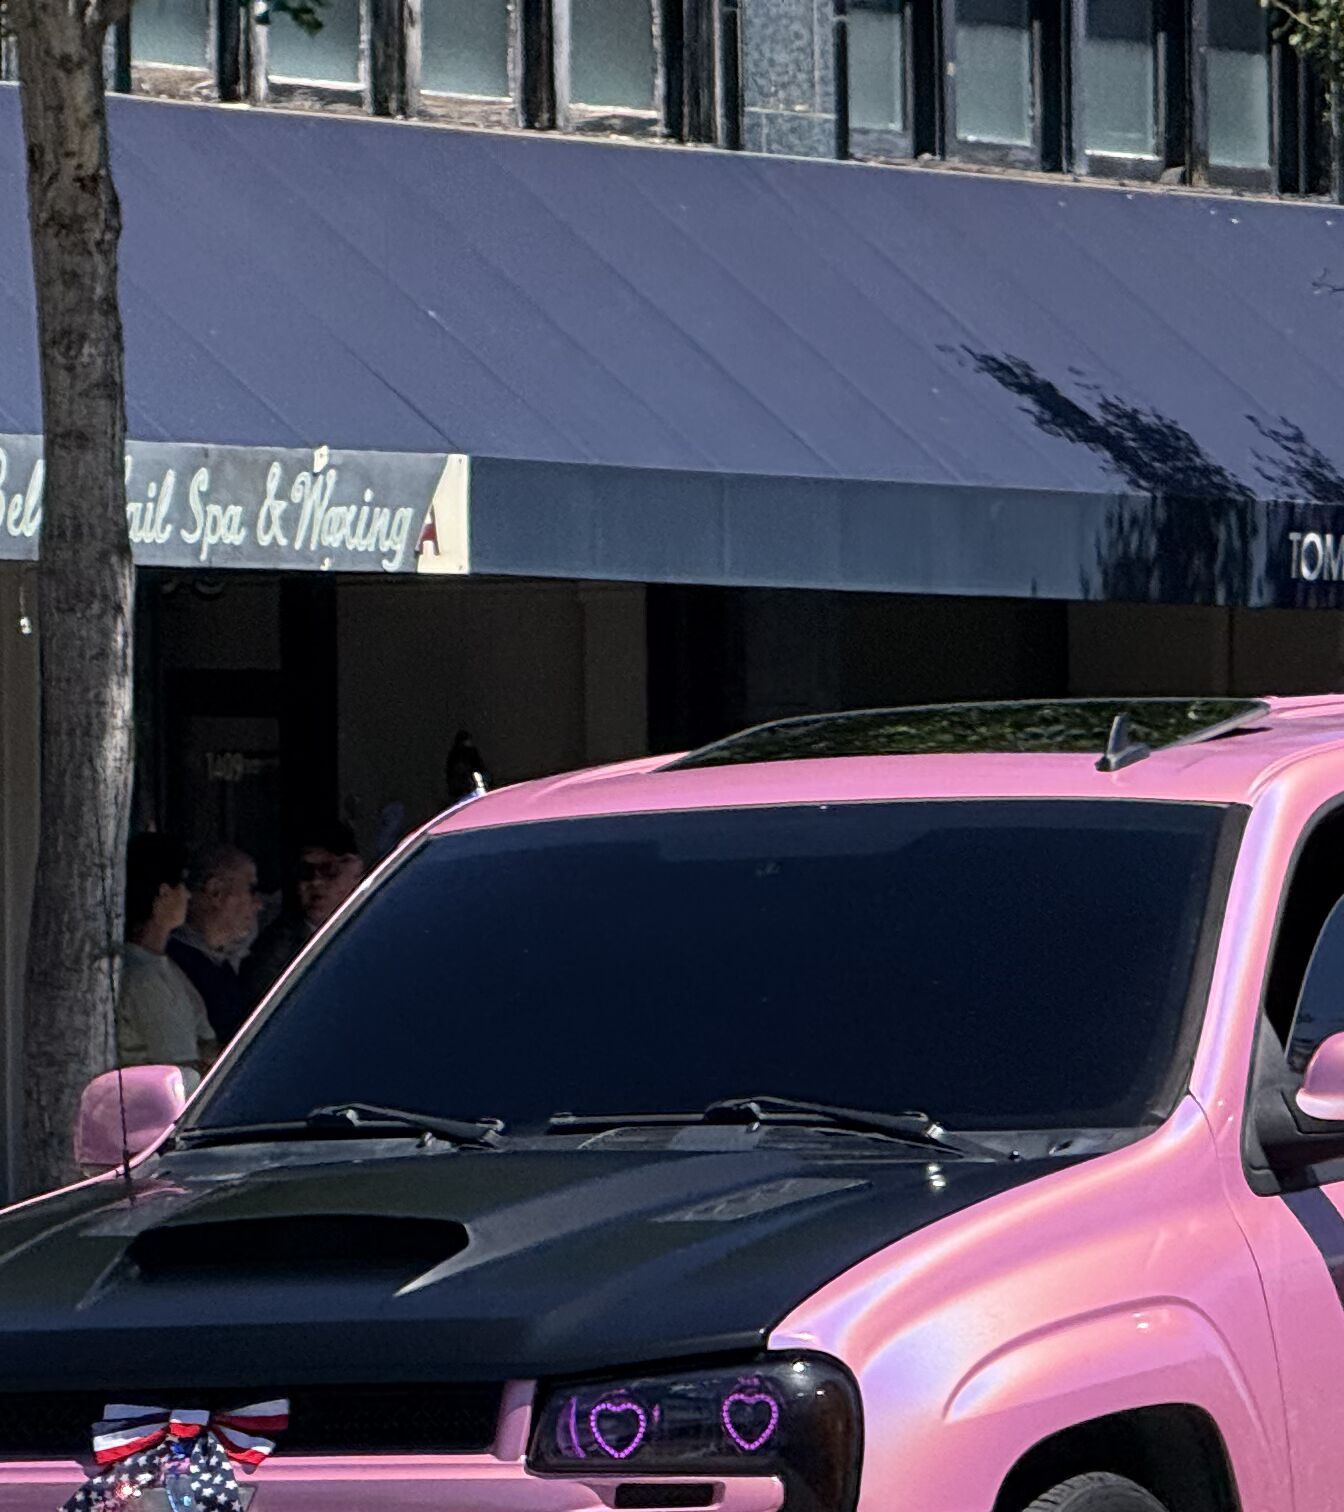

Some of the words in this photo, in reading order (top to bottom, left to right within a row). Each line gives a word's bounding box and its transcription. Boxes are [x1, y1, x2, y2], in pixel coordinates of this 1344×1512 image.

[180, 466, 246, 561] Spa
[257, 461, 287, 547] &
[290, 468, 415, 573] Waxing
